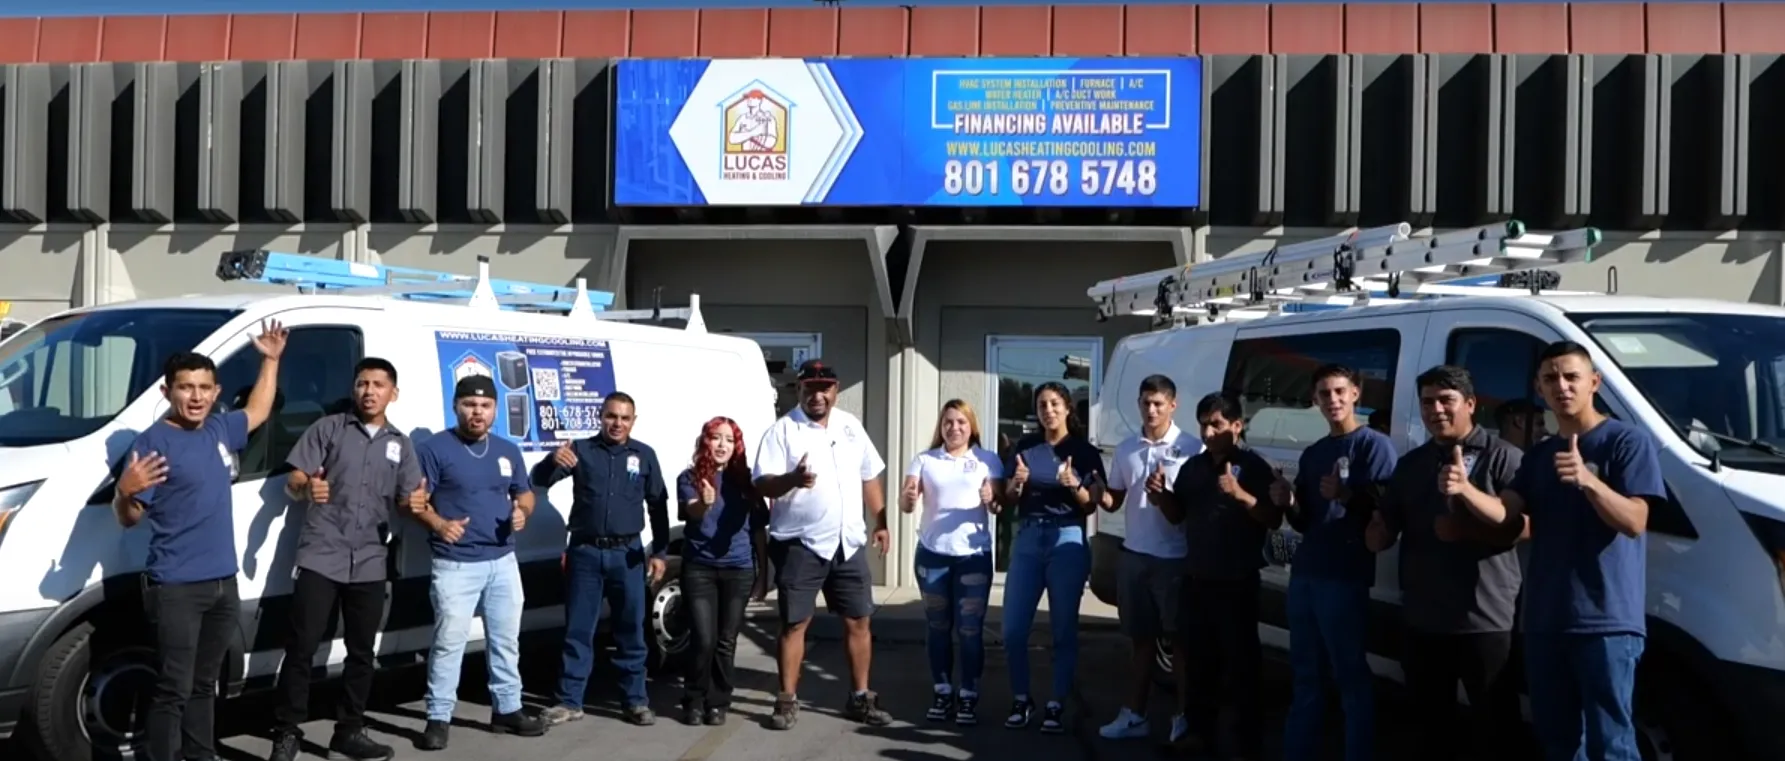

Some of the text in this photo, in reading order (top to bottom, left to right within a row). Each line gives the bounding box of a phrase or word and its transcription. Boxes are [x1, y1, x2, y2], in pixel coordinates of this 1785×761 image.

[981, 79, 1013, 89] SYSTEM
[1014, 79, 1067, 89] INSTALLATION
[1080, 79, 1115, 89] FURNACE
[1128, 79, 1144, 89] A/C
[1013, 90, 1041, 99] HEATER
[1055, 90, 1070, 99] A/C
[1071, 90, 1092, 99] DUCT
[1093, 90, 1117, 99] WORK
[947, 101, 966, 111] GAS
[984, 101, 1037, 111] INSTALLATION
[1051, 101, 1096, 111] PREVENTIVE
[1099, 101, 1154, 111] MAINTENANCE
[954, 113, 1144, 135] FINANCING AVAILABLE
[946, 141, 1156, 157] WWW.LUCASHEATINGCOOLING.COM
[724, 155, 787, 171] LUCAS
[723, 172, 787, 180] HEATING & COOLING
[944, 160, 1157, 196] 801 678 5748
[440, 332, 606, 347] WWW.LUCASHEATINGCOOLING.COM
